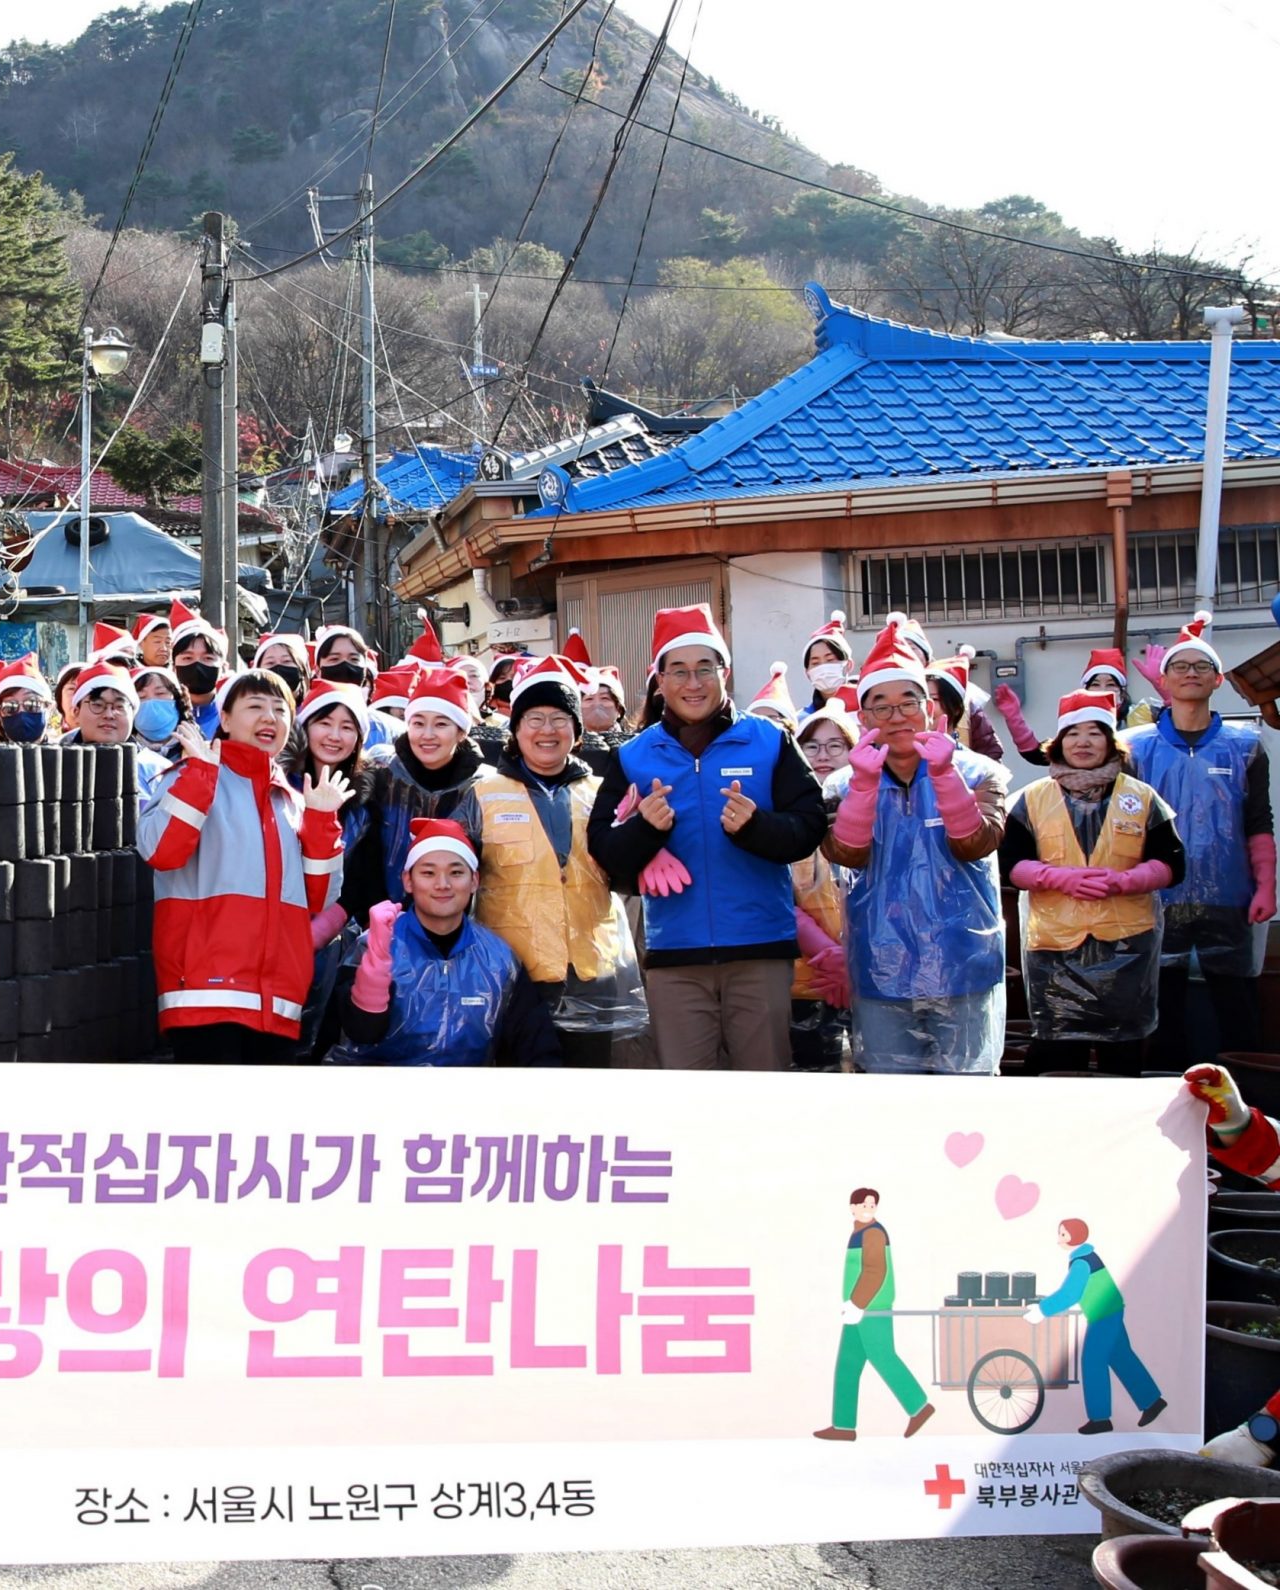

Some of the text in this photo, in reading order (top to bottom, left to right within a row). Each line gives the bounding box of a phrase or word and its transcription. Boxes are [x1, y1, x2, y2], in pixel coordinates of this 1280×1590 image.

[403, 1133, 673, 1204] 함께하는
[243, 1244, 755, 1378] 연탄나눔
[975, 1461, 1055, 1479] 대한적십자사
[75, 1487, 150, 1526] 장소
[183, 1485, 294, 1524] 서울시
[308, 1483, 419, 1522] 노원구
[430, 1480, 596, 1521] 상계3,4동
[976, 1482, 1081, 1509] 북부봉사관
